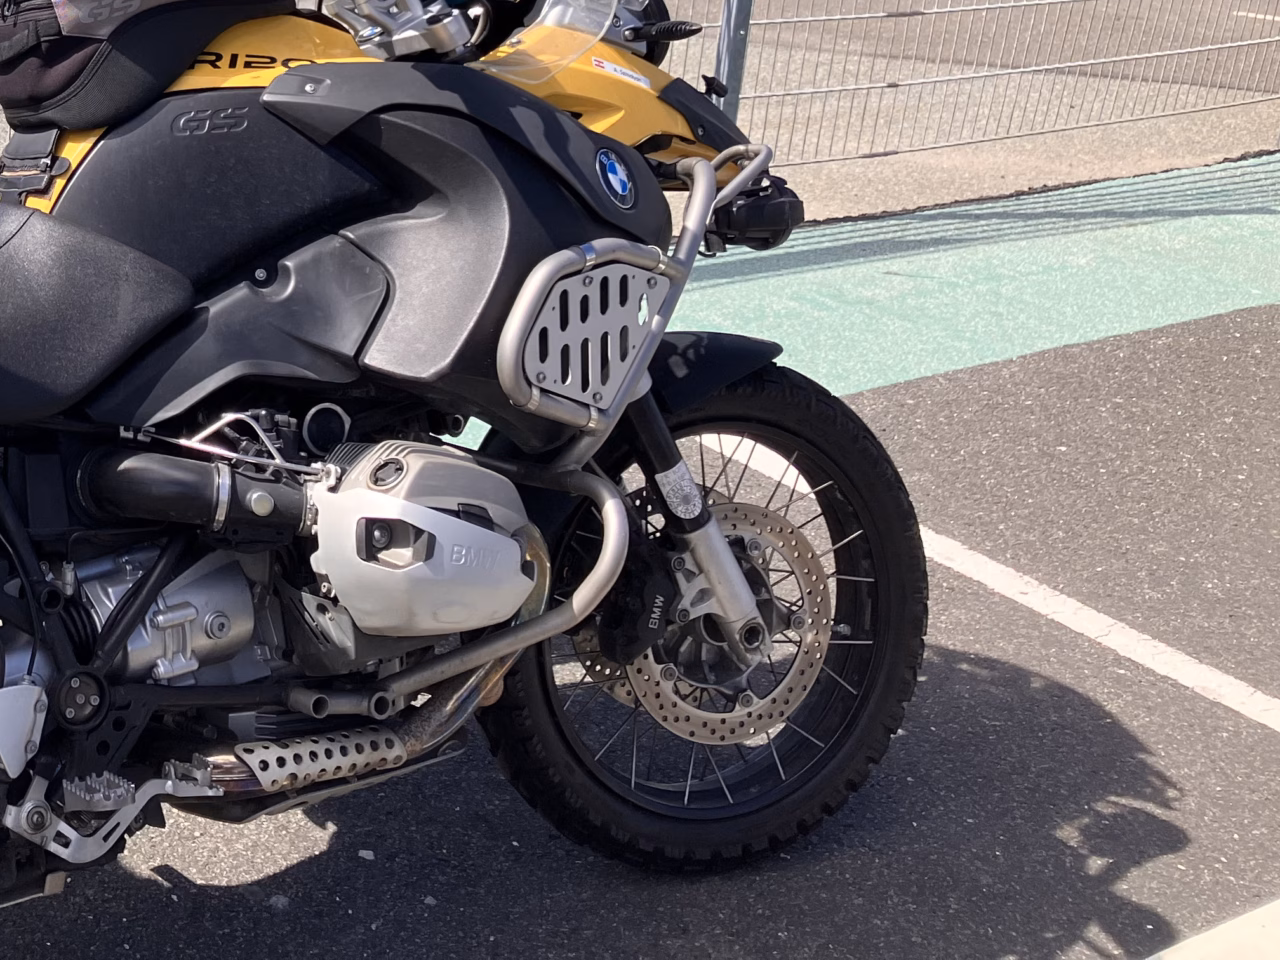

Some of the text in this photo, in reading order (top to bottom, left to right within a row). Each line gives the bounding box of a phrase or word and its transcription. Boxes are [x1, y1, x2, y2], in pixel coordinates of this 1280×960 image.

[171, 107, 249, 136] GS
[450, 543, 501, 570] BMW
[648, 594, 665, 629] BMW
